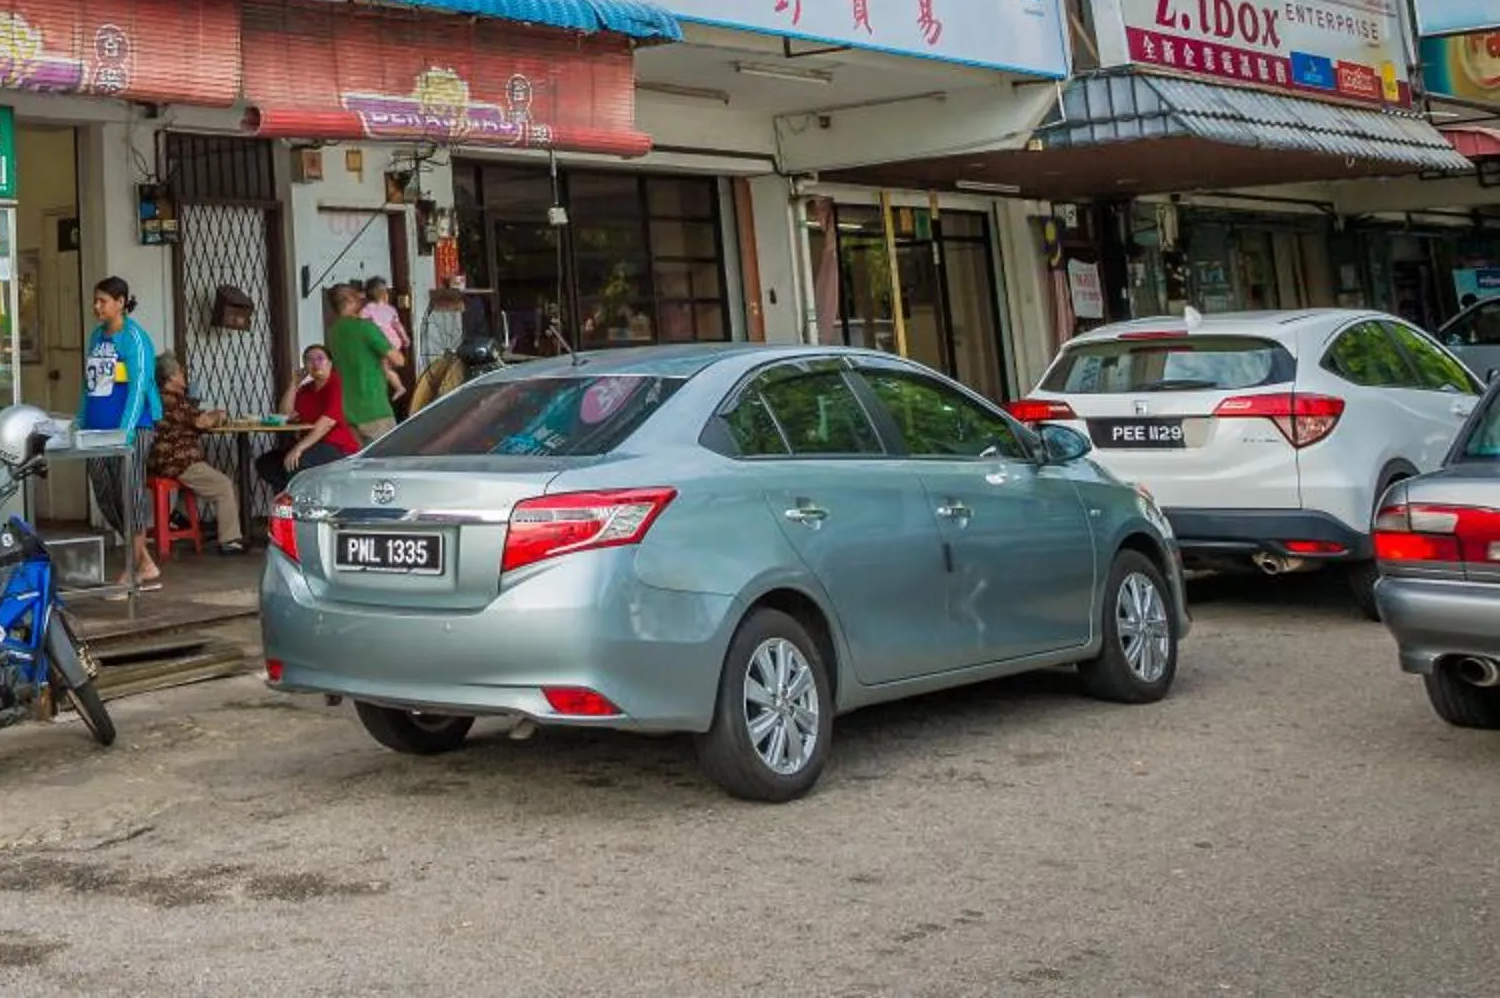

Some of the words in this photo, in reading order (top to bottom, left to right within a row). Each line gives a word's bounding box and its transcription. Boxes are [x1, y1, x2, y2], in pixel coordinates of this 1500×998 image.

[1285, 3, 1380, 41] ENTERPRISE
[1112, 425, 1145, 441] PEE
[387, 539, 428, 565] 1335
